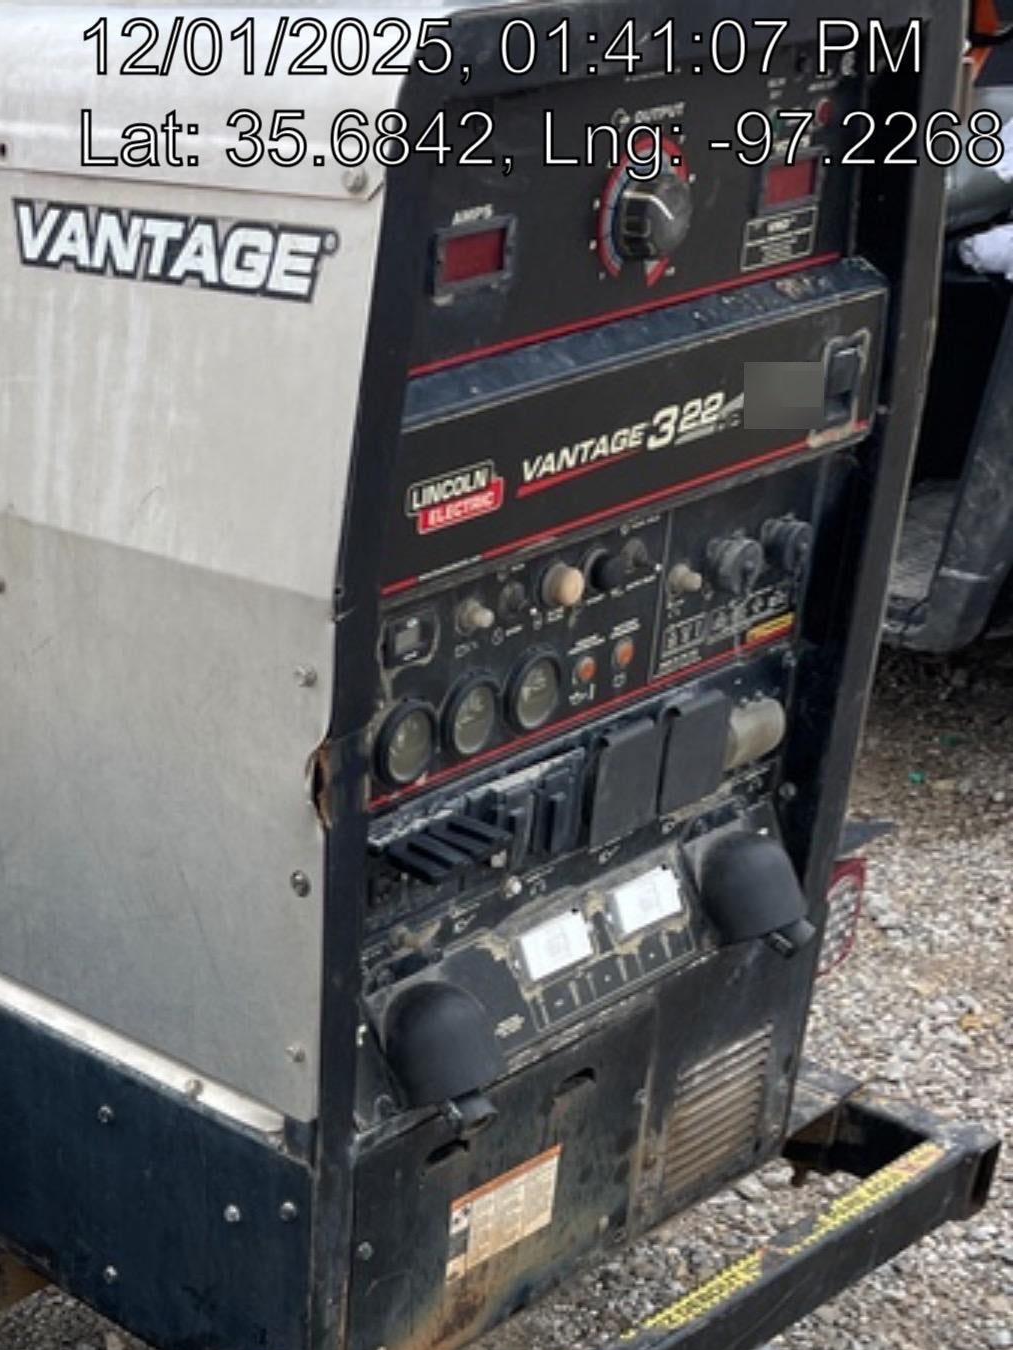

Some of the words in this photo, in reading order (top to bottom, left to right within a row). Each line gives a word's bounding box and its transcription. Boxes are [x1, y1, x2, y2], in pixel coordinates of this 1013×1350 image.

[15, 200, 325, 299] VANTAGE
[521, 422, 651, 483] VANTAGE
[412, 466, 490, 512] LINCOLN
[428, 490, 495, 527] ELECTRIC
